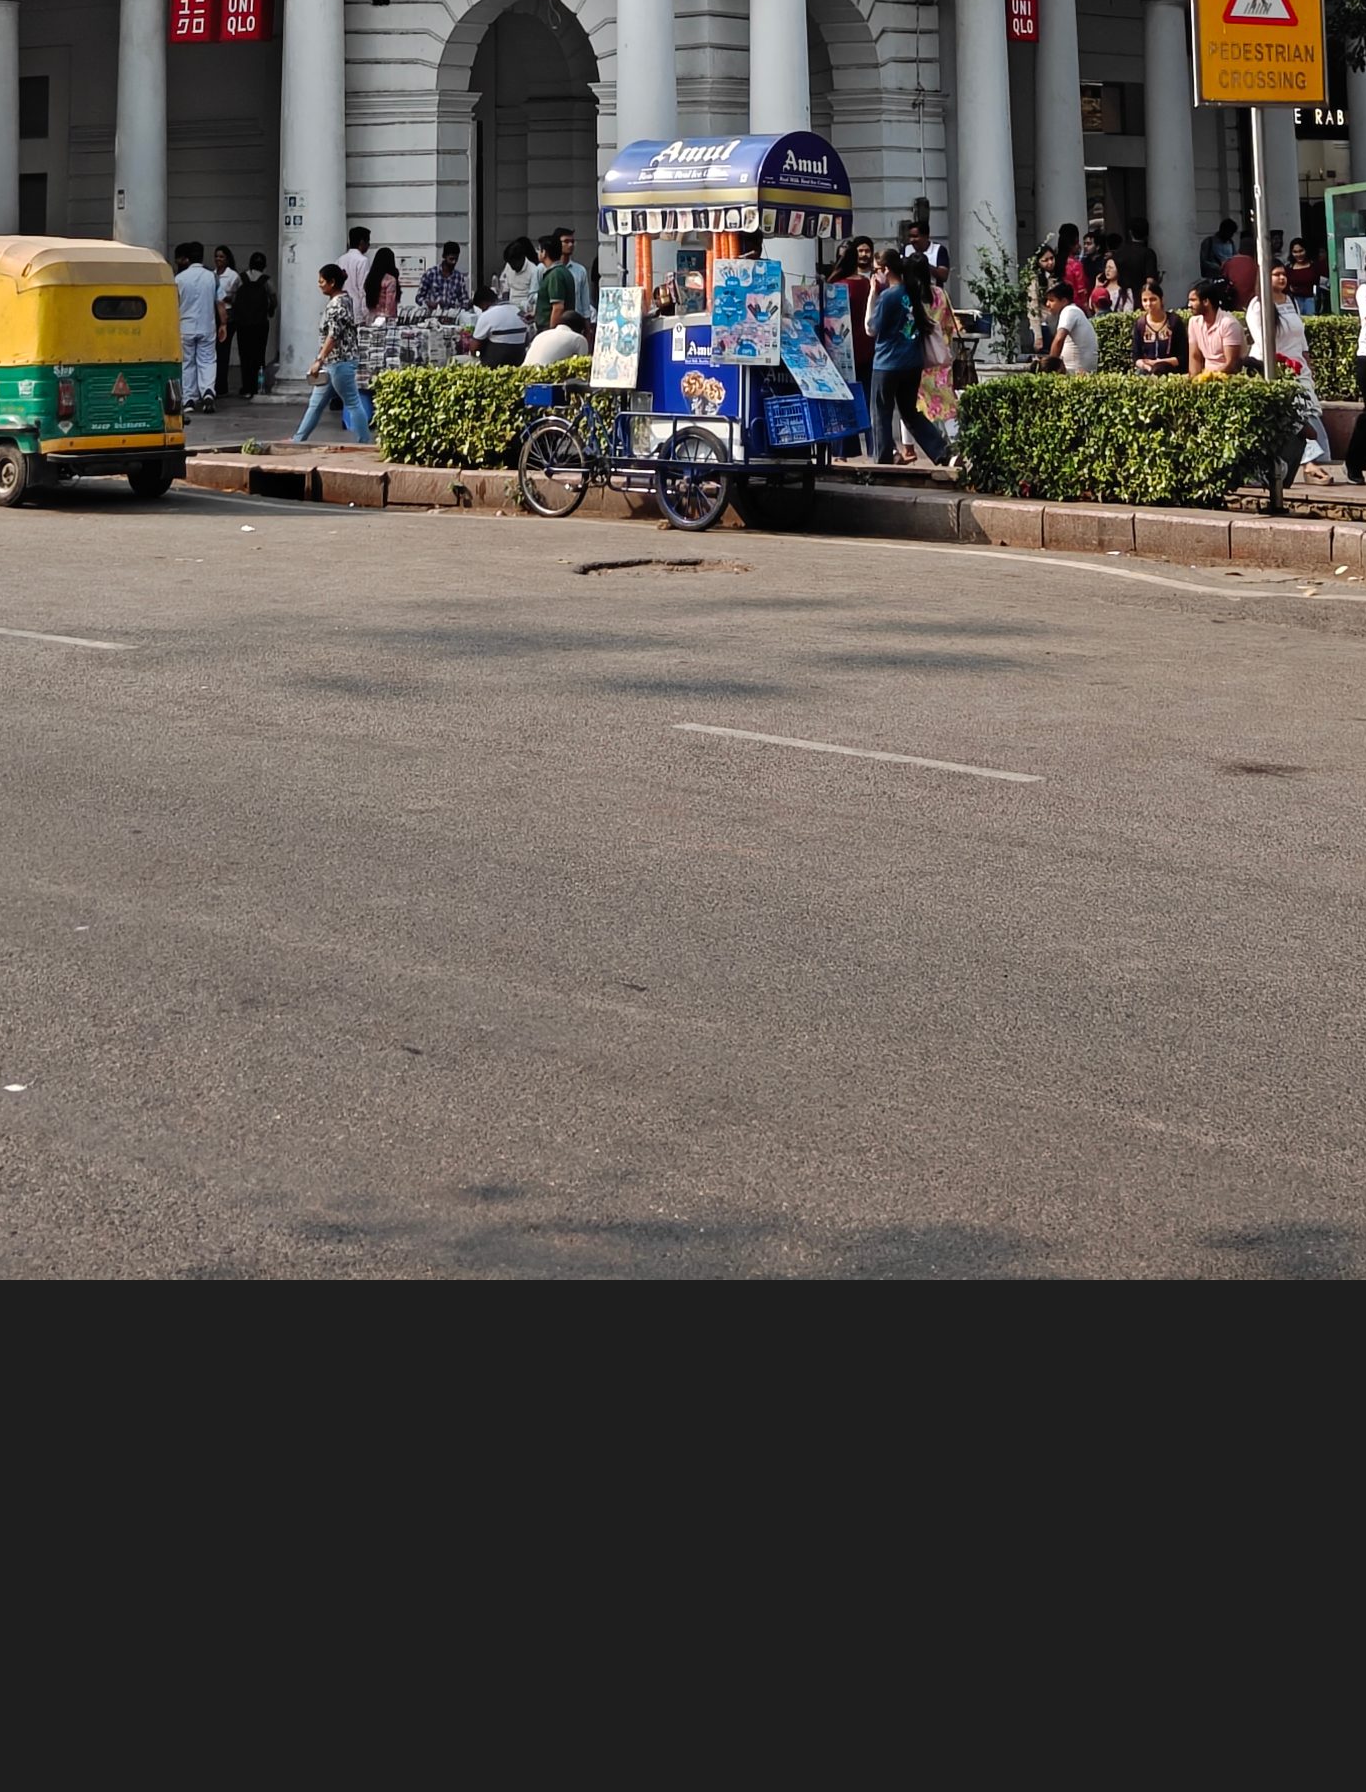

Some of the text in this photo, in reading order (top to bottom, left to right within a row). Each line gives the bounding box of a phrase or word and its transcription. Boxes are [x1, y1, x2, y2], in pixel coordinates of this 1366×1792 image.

[1012, 0, 1031, 16] UNI
[227, 15, 255, 36] QLO
[1013, 18, 1033, 36] QLO
[1208, 41, 1315, 62] PEDESTRIAN
[1218, 69, 1307, 90] CROSSING
[650, 140, 741, 168] Amul
[783, 149, 828, 175] Amul
